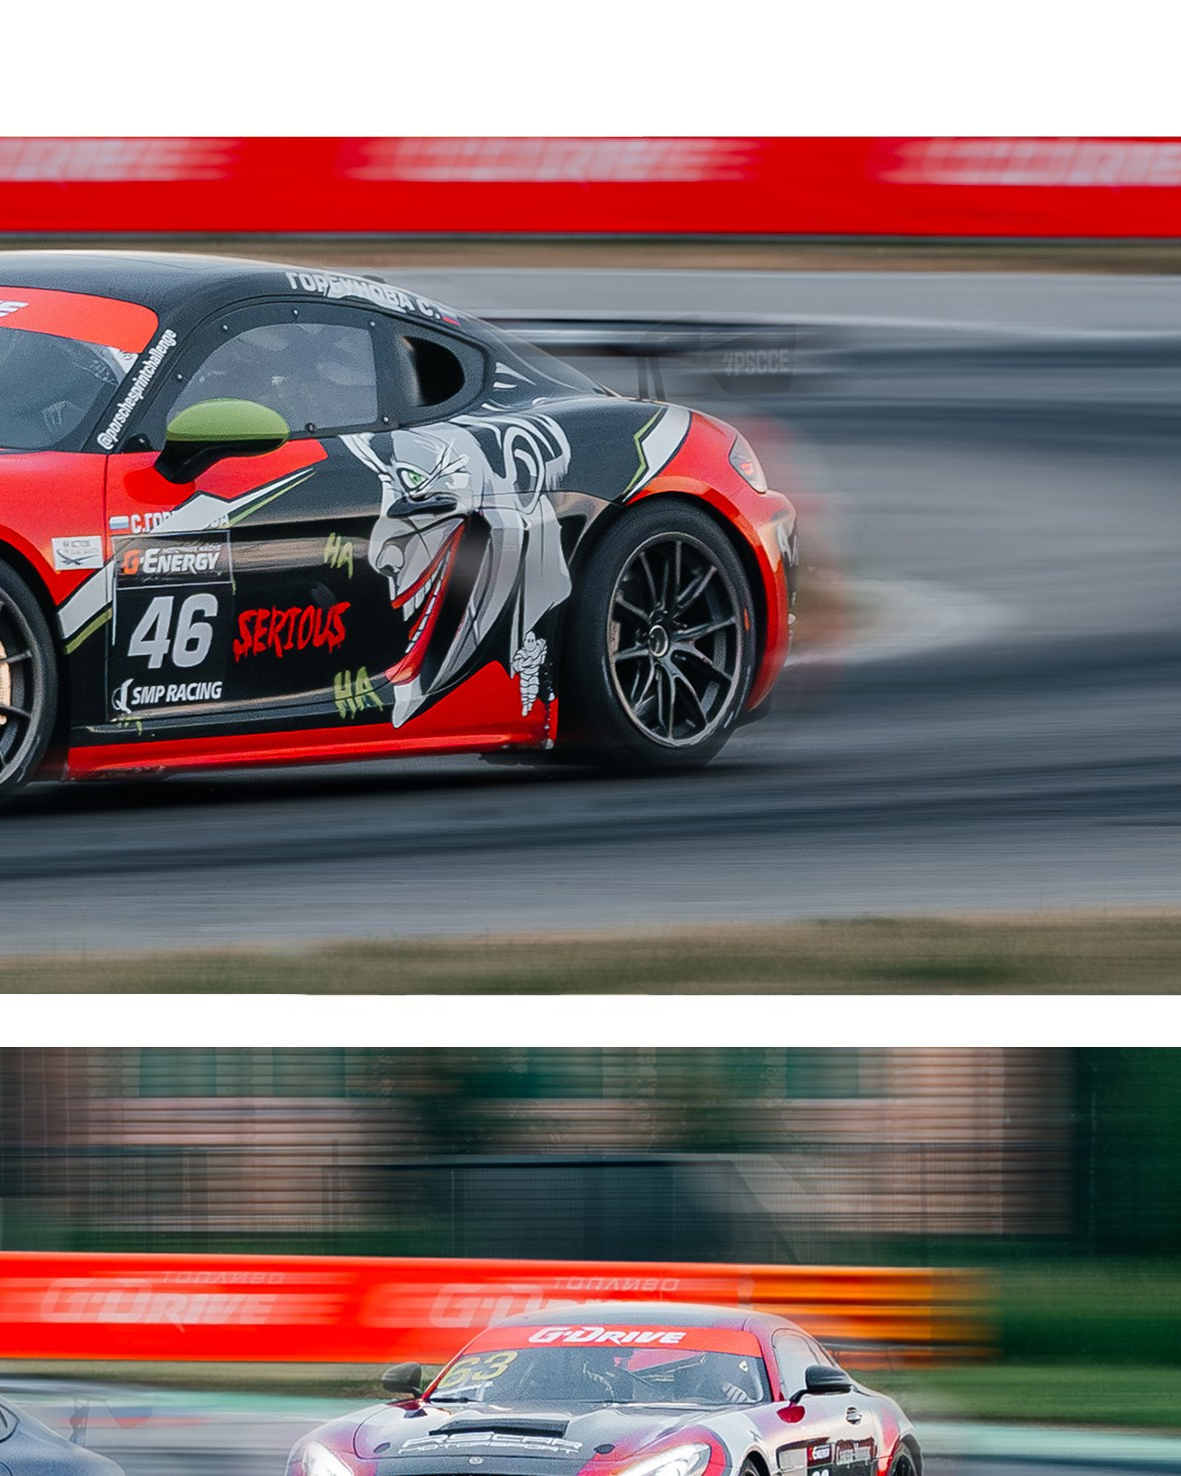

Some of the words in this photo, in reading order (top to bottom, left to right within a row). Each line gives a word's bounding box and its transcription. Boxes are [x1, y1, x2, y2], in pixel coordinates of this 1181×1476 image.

[723, 347, 790, 377] #PSCCE
[96, 328, 177, 450] @porschesprintchallenge
[323, 532, 354, 580] HA
[127, 593, 220, 670] 46
[232, 601, 352, 664] SERIOUS
[131, 685, 165, 705] SMP
[166, 681, 224, 702] RACING
[333, 665, 384, 721] HA
[437, 1350, 518, 1389] 63
